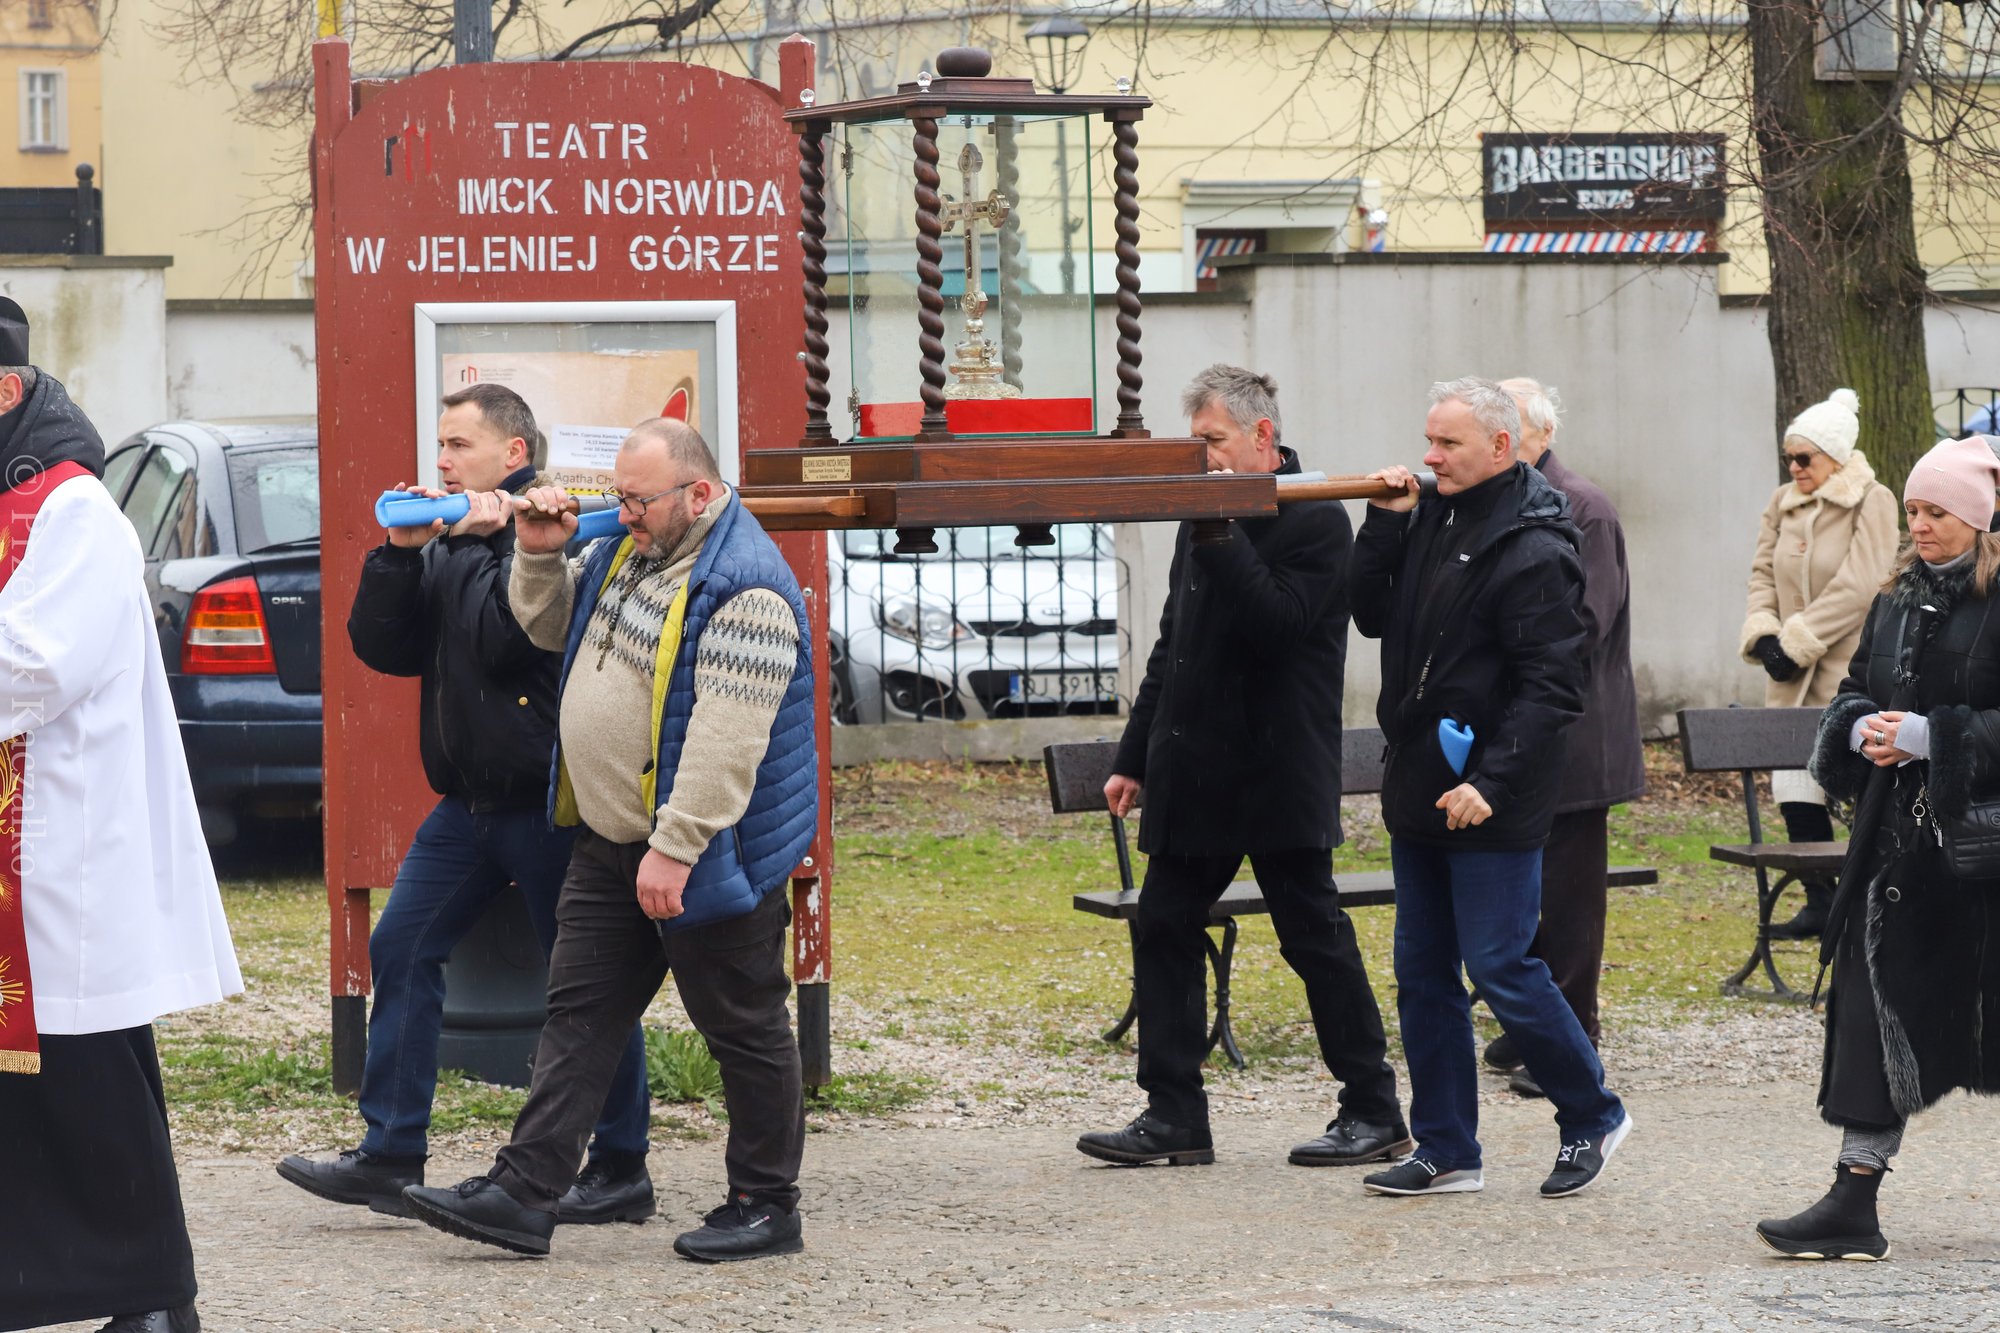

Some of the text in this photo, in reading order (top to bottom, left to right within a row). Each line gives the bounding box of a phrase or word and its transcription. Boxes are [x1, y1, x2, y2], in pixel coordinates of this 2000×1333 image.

[494, 122, 650, 160] TEATR
[1491, 145, 1717, 194] BARBERSHOP
[584, 178, 786, 216] NORWIDA
[346, 226, 780, 274] W JELENIEJ GÓRZE
[554, 472, 593, 487] Agatha
[271, 596, 306, 605] OPEL
